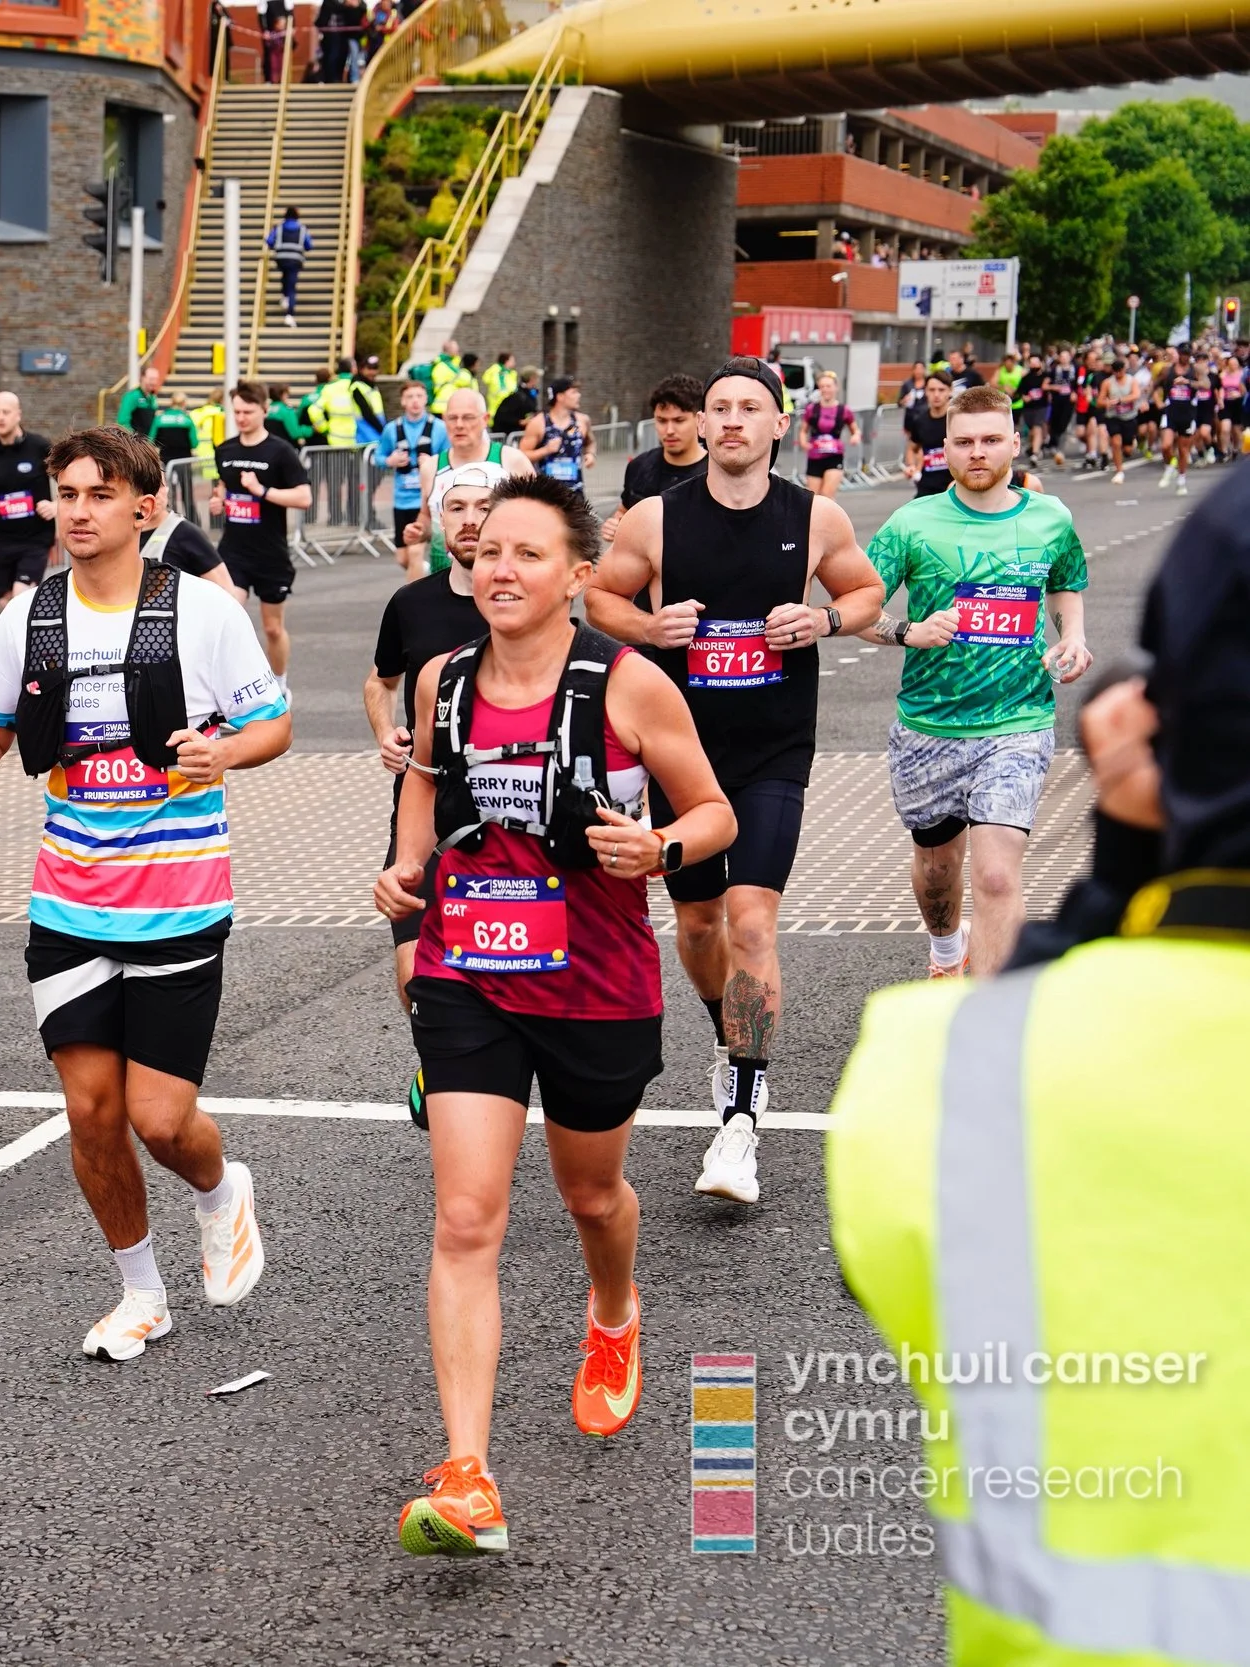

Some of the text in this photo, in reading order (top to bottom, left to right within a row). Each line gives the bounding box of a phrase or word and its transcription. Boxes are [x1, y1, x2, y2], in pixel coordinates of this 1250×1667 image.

[998, 586, 1027, 594] SWANSEA
[956, 601, 988, 610] DYLAN
[732, 620, 765, 629] SWANSEA
[970, 612, 1021, 632] 5121
[968, 636, 1020, 644] #RUNSWANSEA
[688, 642, 736, 650] ANDREW
[706, 650, 765, 673] 6712
[69, 682, 106, 692] ancer
[706, 677, 765, 687] #RUNSWANSEA
[80, 758, 146, 784] 7803
[470, 777, 508, 790] ERRY
[84, 790, 146, 800] #RUNSWANSEA
[492, 880, 537, 889] SWANSEA
[444, 904, 468, 917] CAT
[474, 920, 528, 951] 628
[466, 957, 542, 970] #RUNSWANSEA
